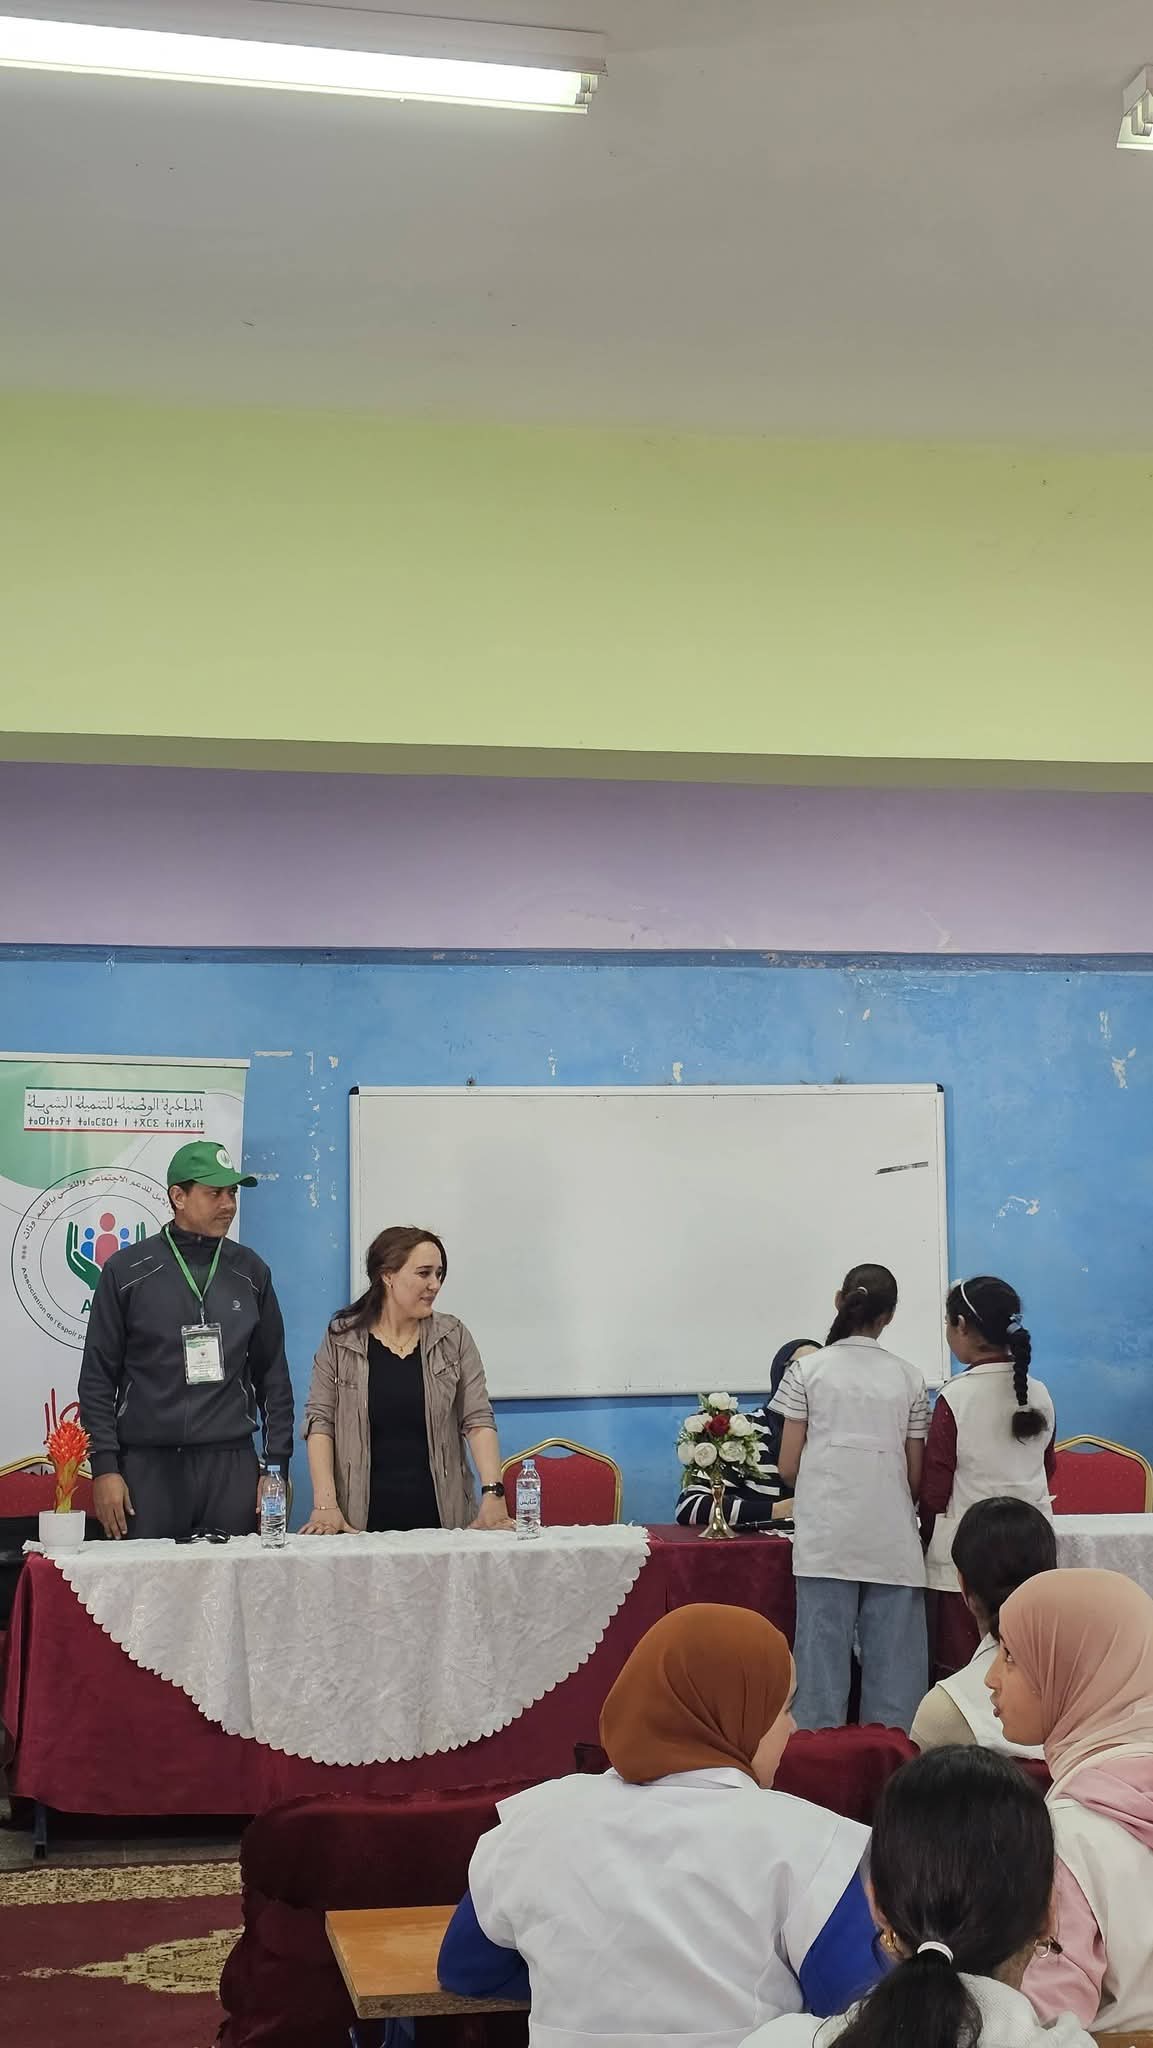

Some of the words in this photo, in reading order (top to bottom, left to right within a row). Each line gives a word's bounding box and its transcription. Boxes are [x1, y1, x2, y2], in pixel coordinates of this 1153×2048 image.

[26, 1094, 73, 1115] البشرية
[75, 1095, 114, 1113] للتنمية
[116, 1096, 159, 1117] الوطنية
[21, 1266, 47, 1314] Association
[46, 1311, 54, 1322] de
